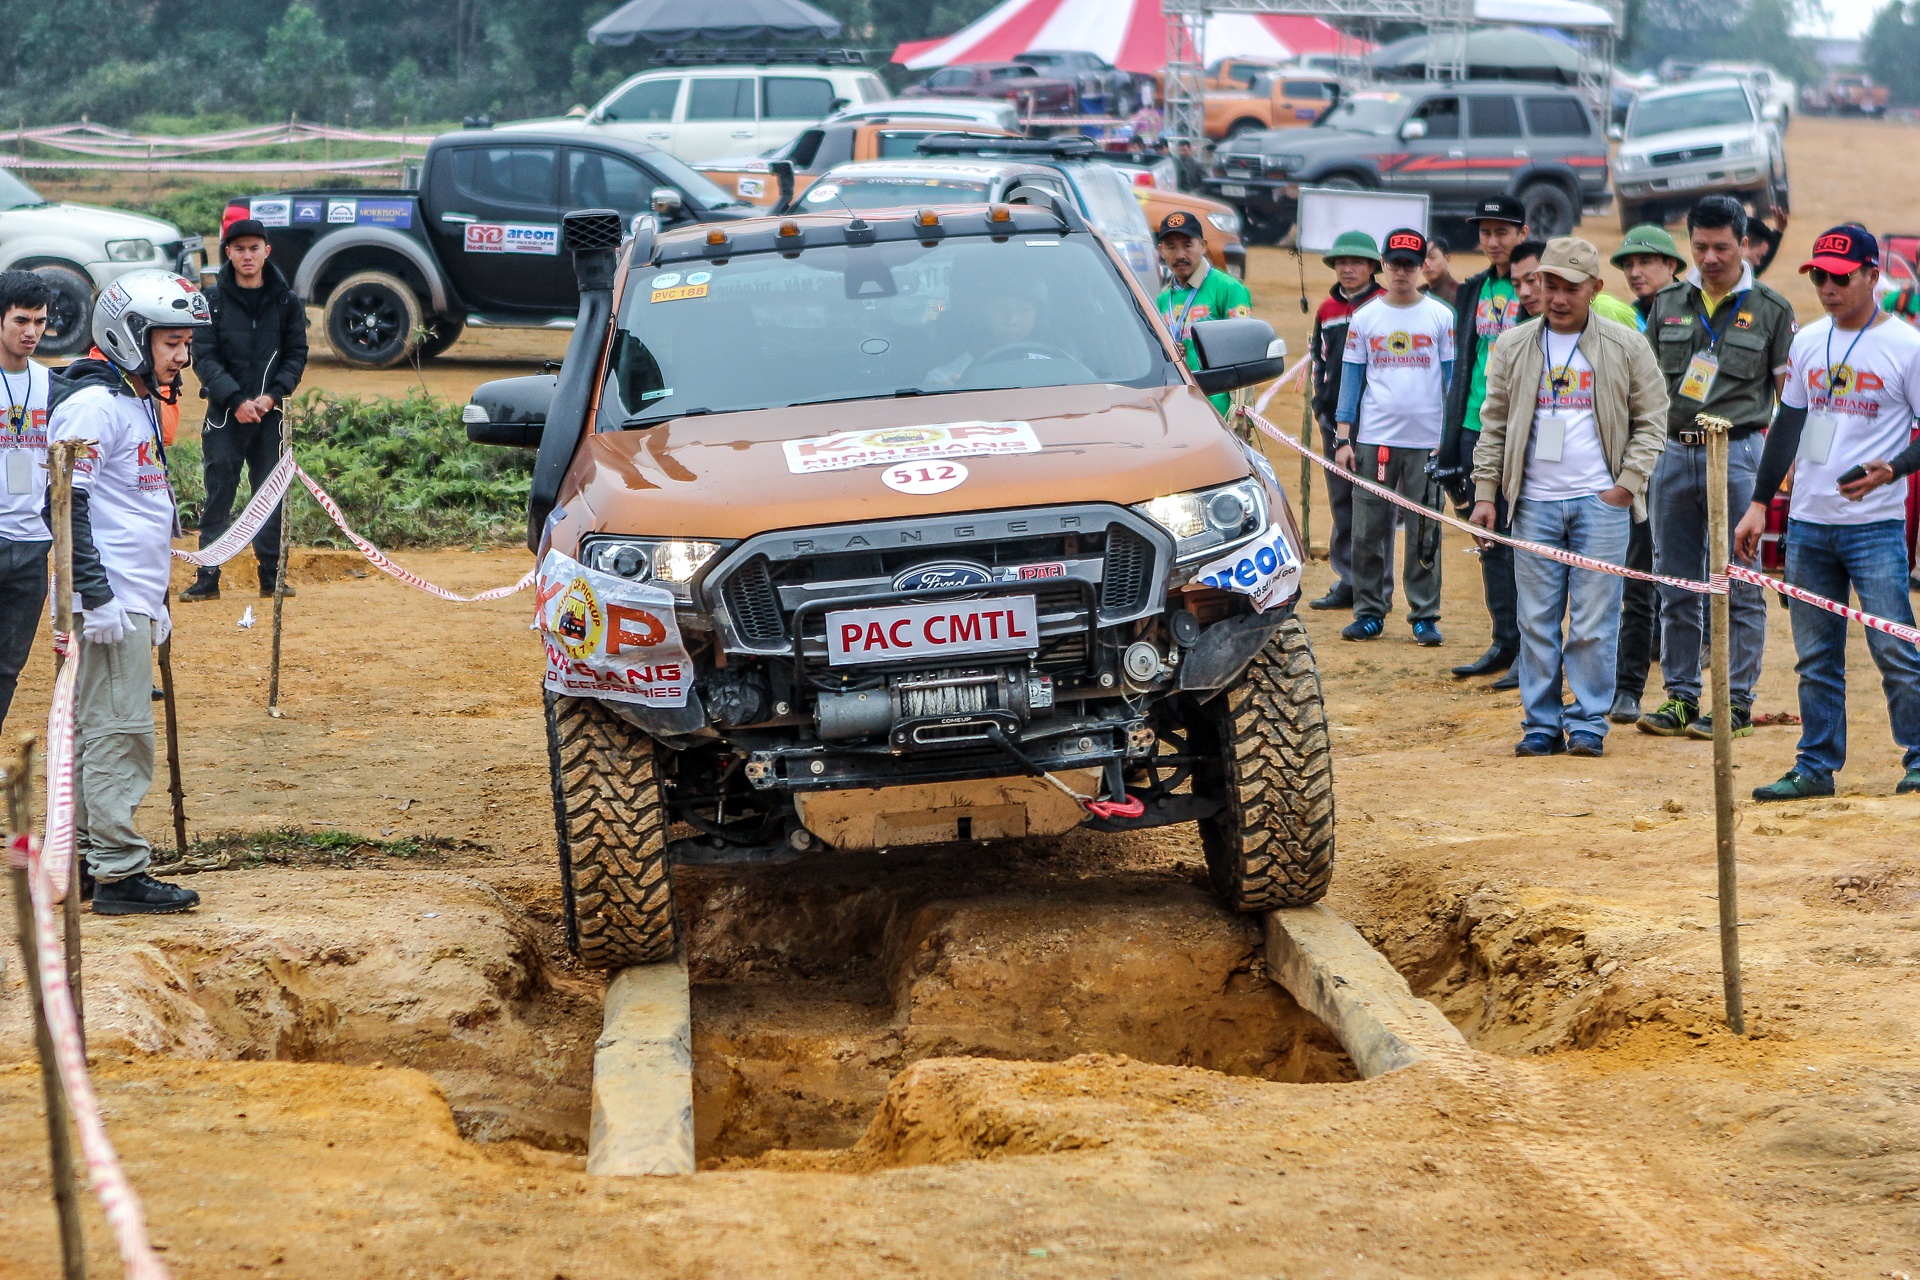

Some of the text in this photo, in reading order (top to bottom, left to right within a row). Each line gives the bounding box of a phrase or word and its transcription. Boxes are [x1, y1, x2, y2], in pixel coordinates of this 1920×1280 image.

[850, 163, 990, 174] NISSAN
[260, 203, 279, 212] Ford
[359, 208, 401, 218] MORRISON
[507, 229, 555, 241] areon
[1393, 237, 1418, 247] PAC
[1815, 238, 1846, 250] PAC
[655, 287, 704, 301] PVC 188
[1537, 396, 1592, 405] NH GIAN
[16, 435, 47, 443] GIAN
[803, 441, 1026, 466] MINH GIANG
[806, 458, 866, 470] AUTO
[139, 474, 161, 484] MINH
[894, 466, 957, 484] 512
[793, 516, 1081, 551] RANGER
[1024, 566, 1060, 580] PAC
[917, 571, 970, 589] Ford
[581, 583, 601, 628] PICKUP
[563, 622, 582, 631] CLUB
[841, 609, 1027, 653] PAC CMTL
[941, 716, 972, 724] COMEUP
